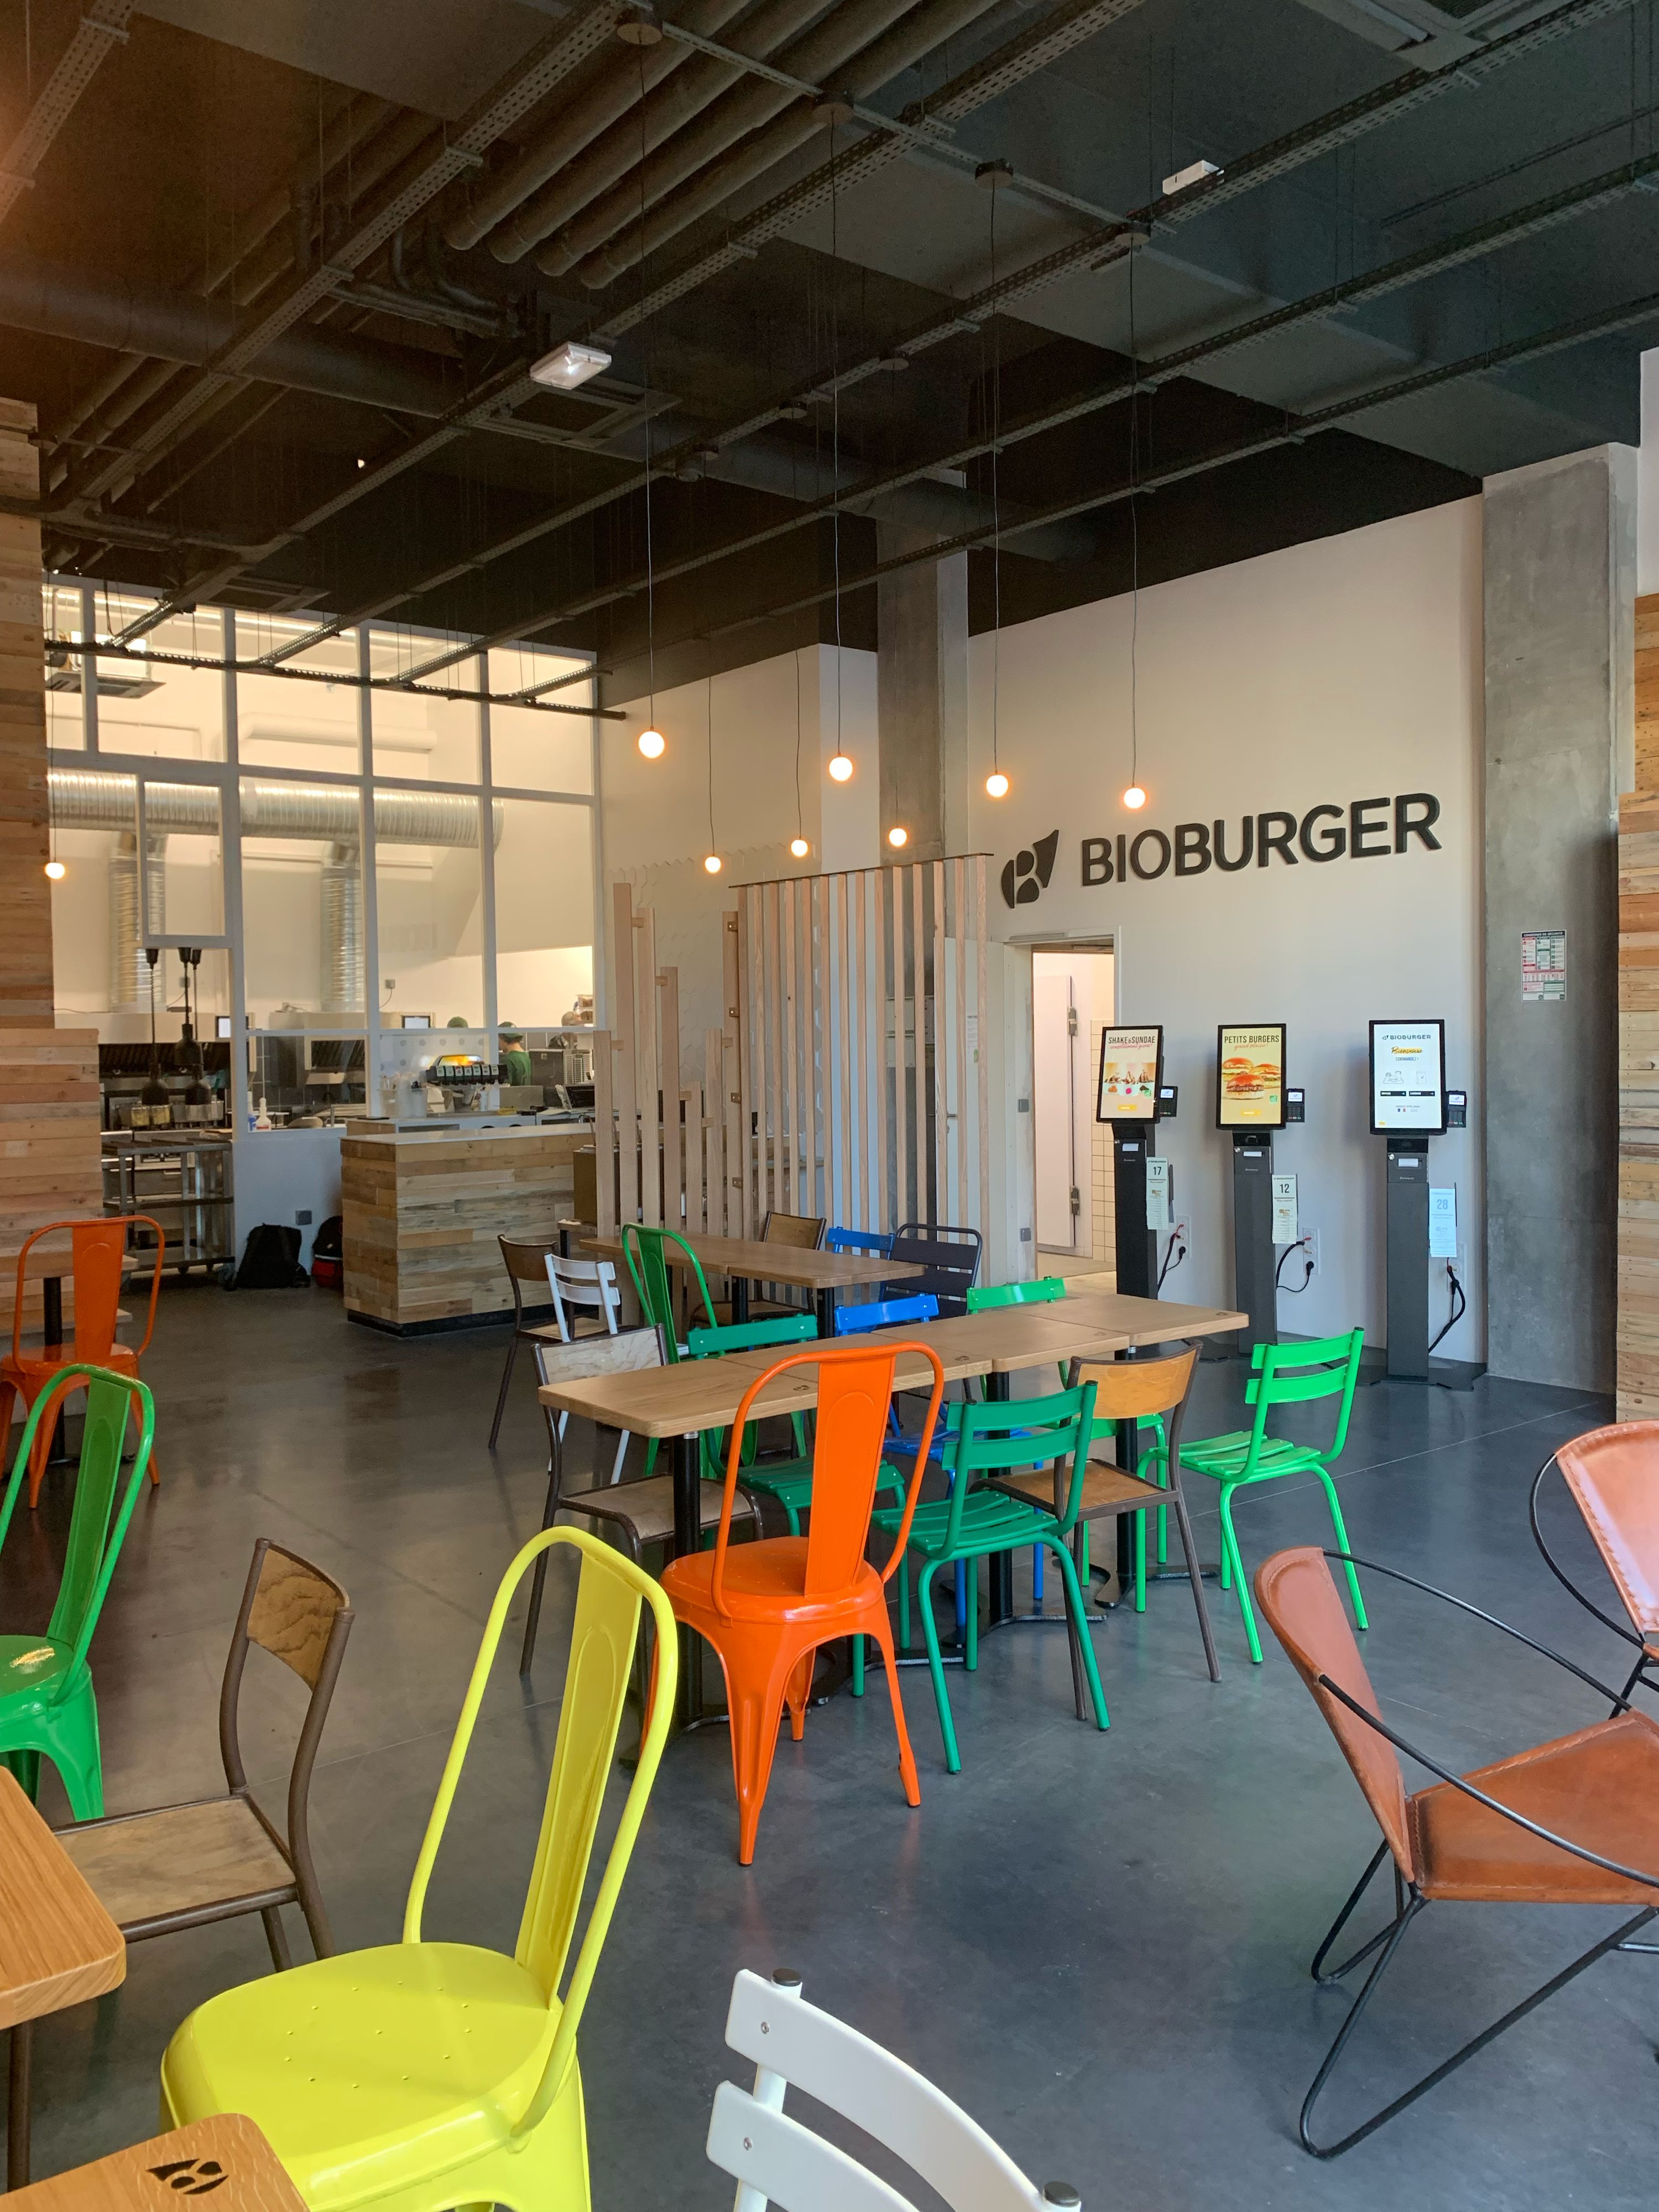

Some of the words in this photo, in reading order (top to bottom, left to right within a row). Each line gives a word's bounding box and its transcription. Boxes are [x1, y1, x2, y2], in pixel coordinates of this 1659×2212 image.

[1082, 793, 1442, 886] BIOBURGER
[1249, 1035, 1280, 1043] BURGERS
[1391, 1046, 1423, 1054] Bienvenue
[1153, 1166, 1162, 1176] 17
[1279, 1183, 1290, 1193] 12
[1436, 1199, 1448, 1210] 28
